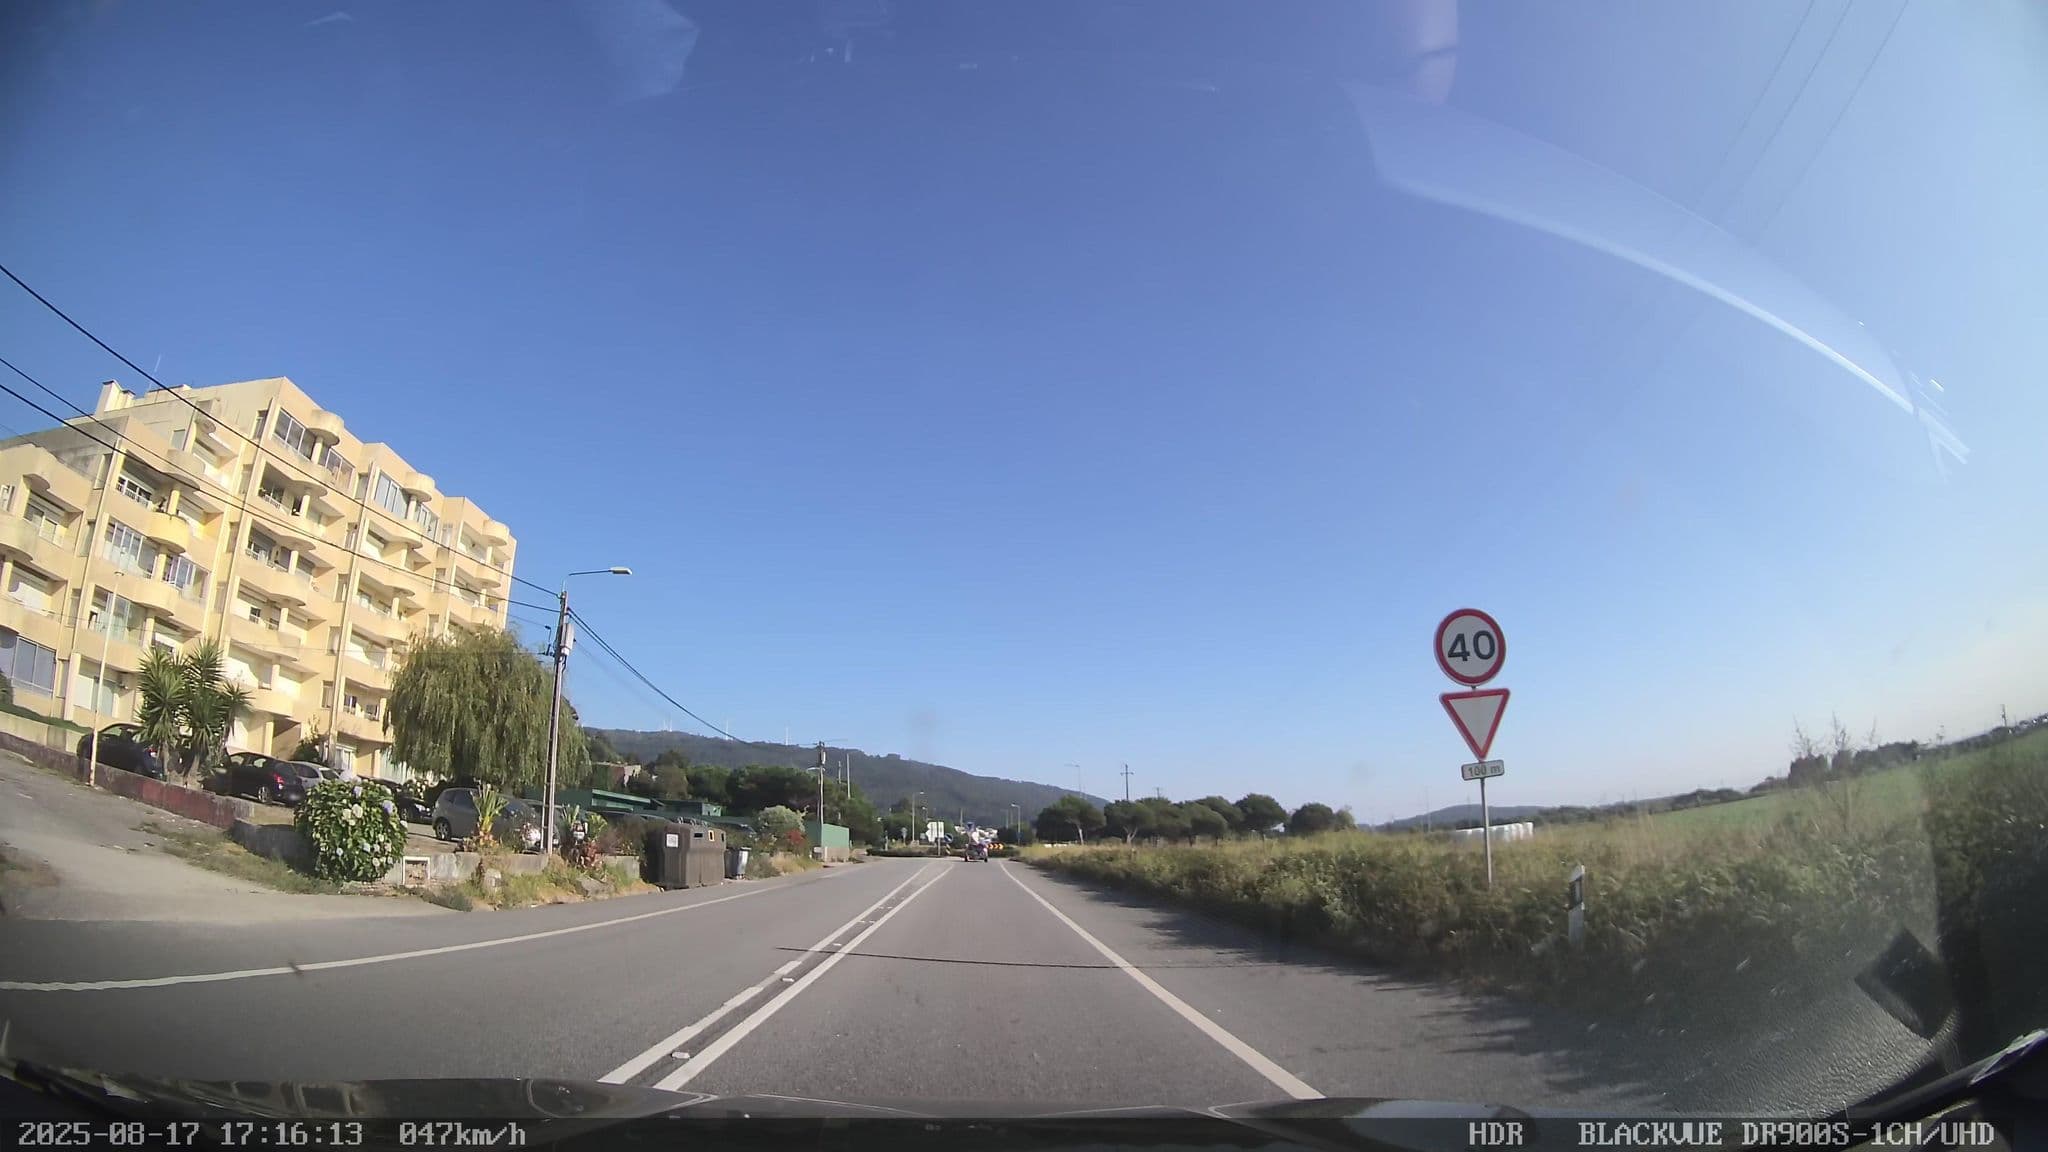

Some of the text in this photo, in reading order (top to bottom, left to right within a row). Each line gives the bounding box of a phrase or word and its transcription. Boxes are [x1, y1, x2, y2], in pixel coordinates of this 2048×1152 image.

[1447, 630, 1495, 662] 40
[1468, 765, 1501, 777] 100 m
